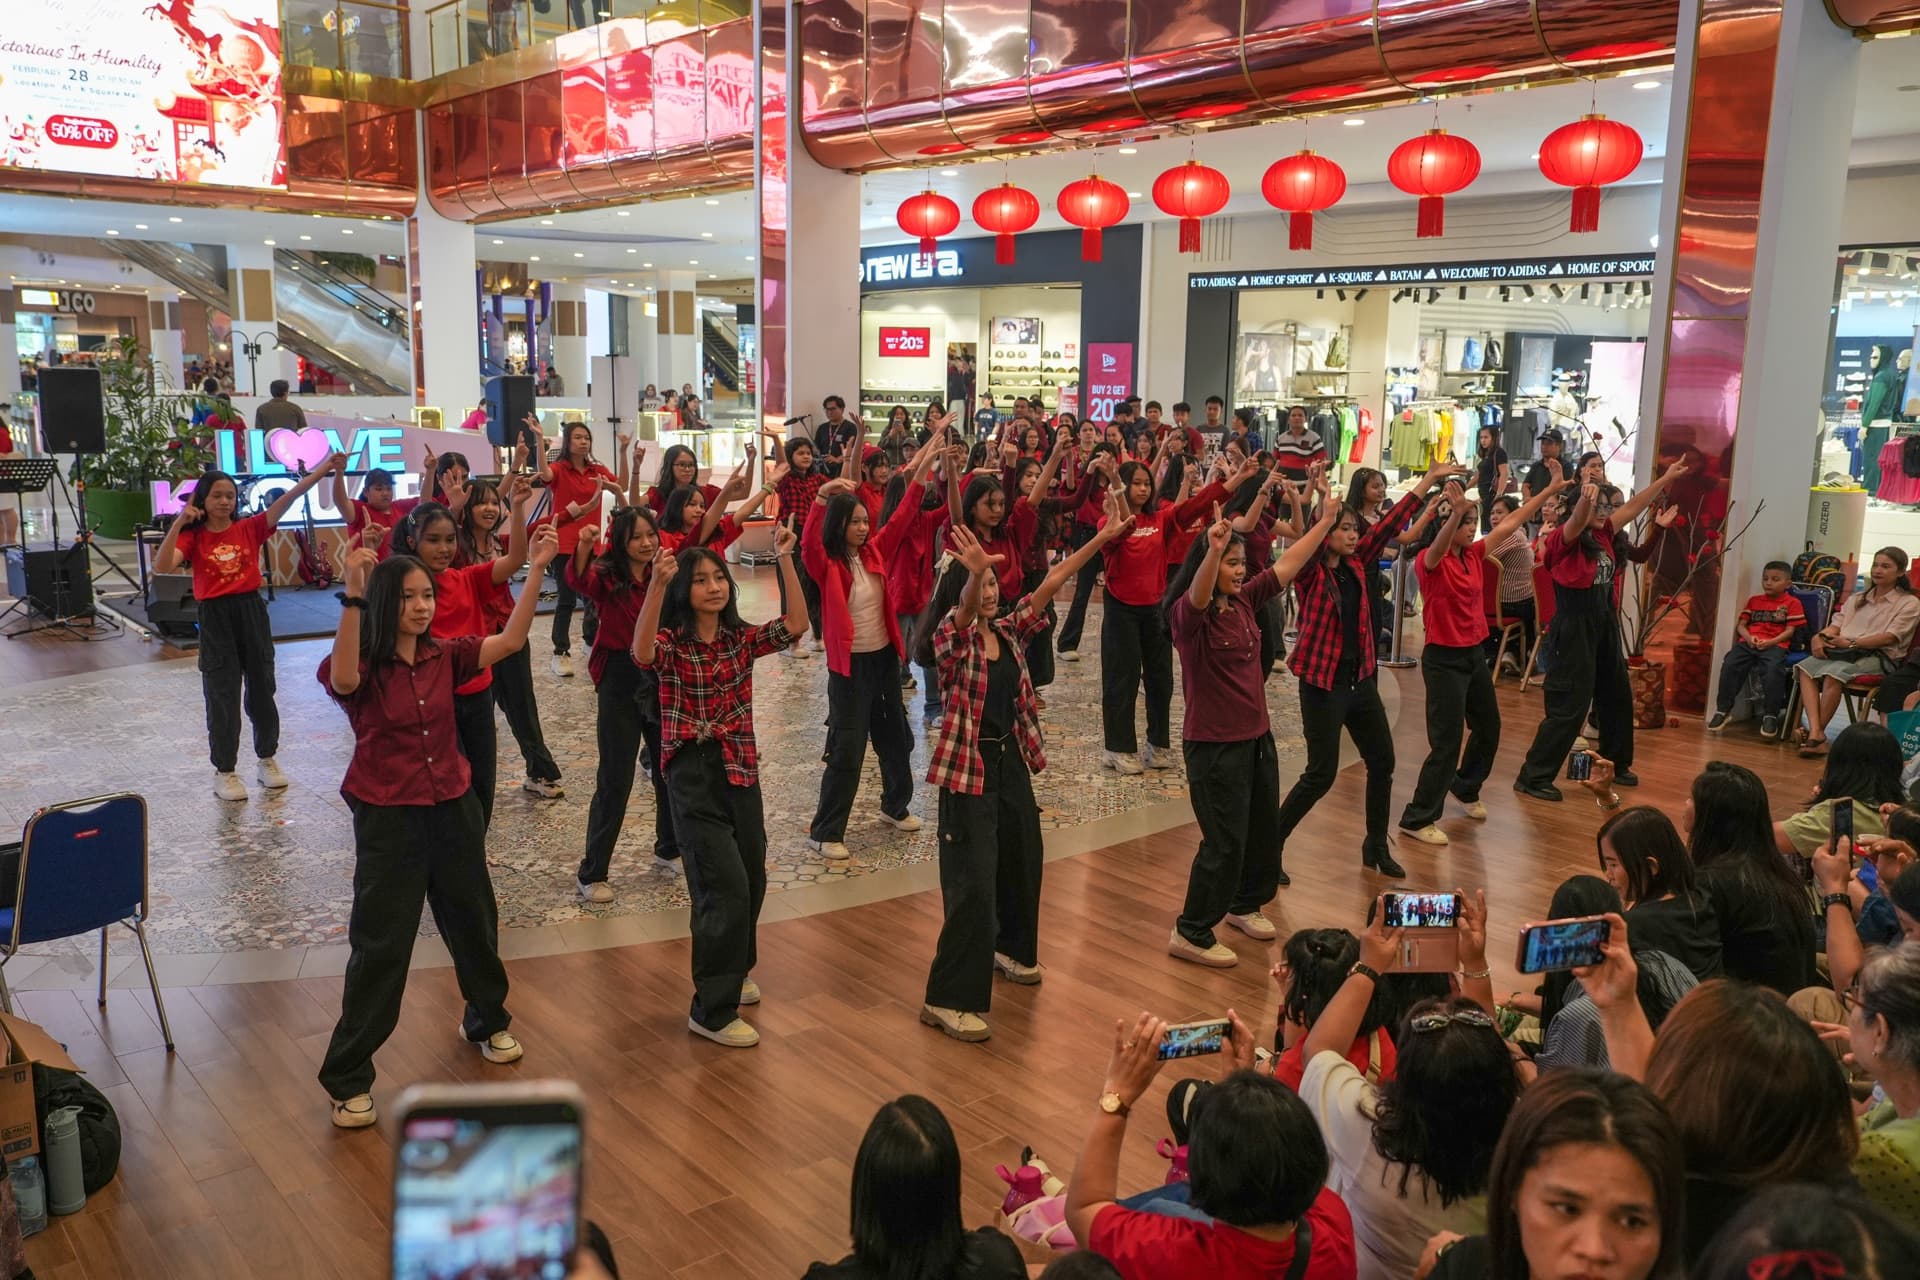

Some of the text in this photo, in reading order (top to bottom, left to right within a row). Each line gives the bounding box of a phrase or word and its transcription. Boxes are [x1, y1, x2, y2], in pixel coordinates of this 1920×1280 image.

[0, 39, 162, 78] ctorious In Humility
[68, 68, 89, 82] 28
[51, 122, 116, 143] 50% OFF
[1197, 277, 1208, 288] TO
[1208, 276, 1237, 287] ADIDAS
[1250, 275, 1274, 286] HOME
[1275, 274, 1286, 285] OF
[1286, 273, 1314, 285] SPORT
[1328, 270, 1373, 284] K-SQUARE
[1390, 269, 1422, 281] BATAM
[1440, 266, 1490, 279] WELCOME
[1491, 265, 1507, 278] TO
[1507, 264, 1547, 277] ADIDAS
[1567, 261, 1601, 275] HOME
[1601, 261, 1618, 273] OF
[1619, 259, 1655, 273] SPORT
[1091, 384, 1126, 395] BUY 2 GET
[1819, 501, 1831, 536] ADIZERO
